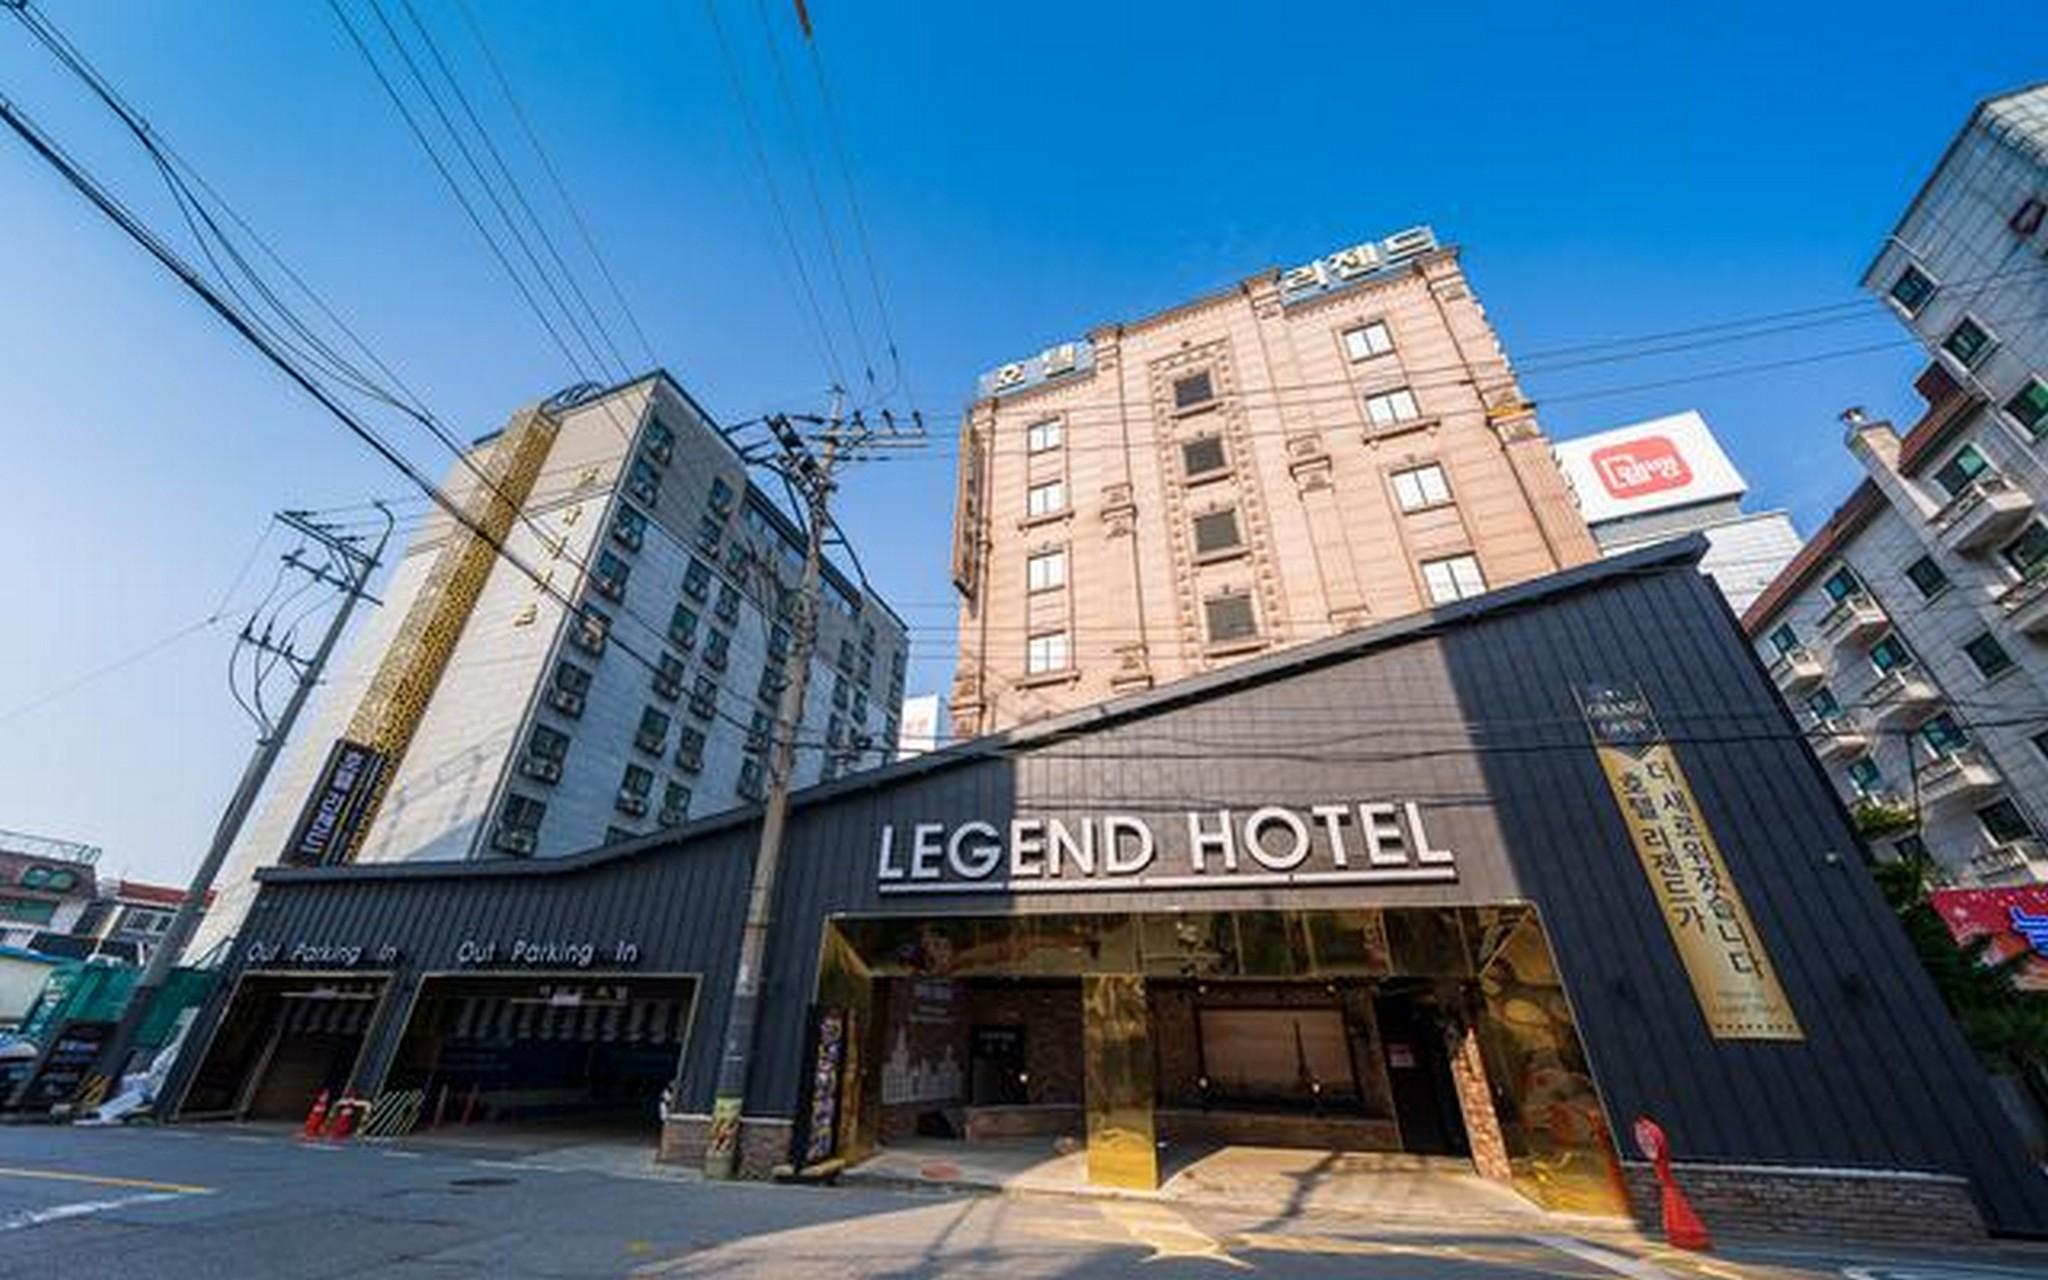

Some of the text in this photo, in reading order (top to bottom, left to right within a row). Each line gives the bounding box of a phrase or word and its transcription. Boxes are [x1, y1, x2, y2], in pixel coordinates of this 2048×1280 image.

[1646, 759, 1678, 786] 더
[1618, 769, 1660, 820] 호텔
[878, 801, 1454, 880] LEGEND HOTEL
[247, 940, 398, 967] Out Parking In
[457, 939, 638, 968] Out Parking In
